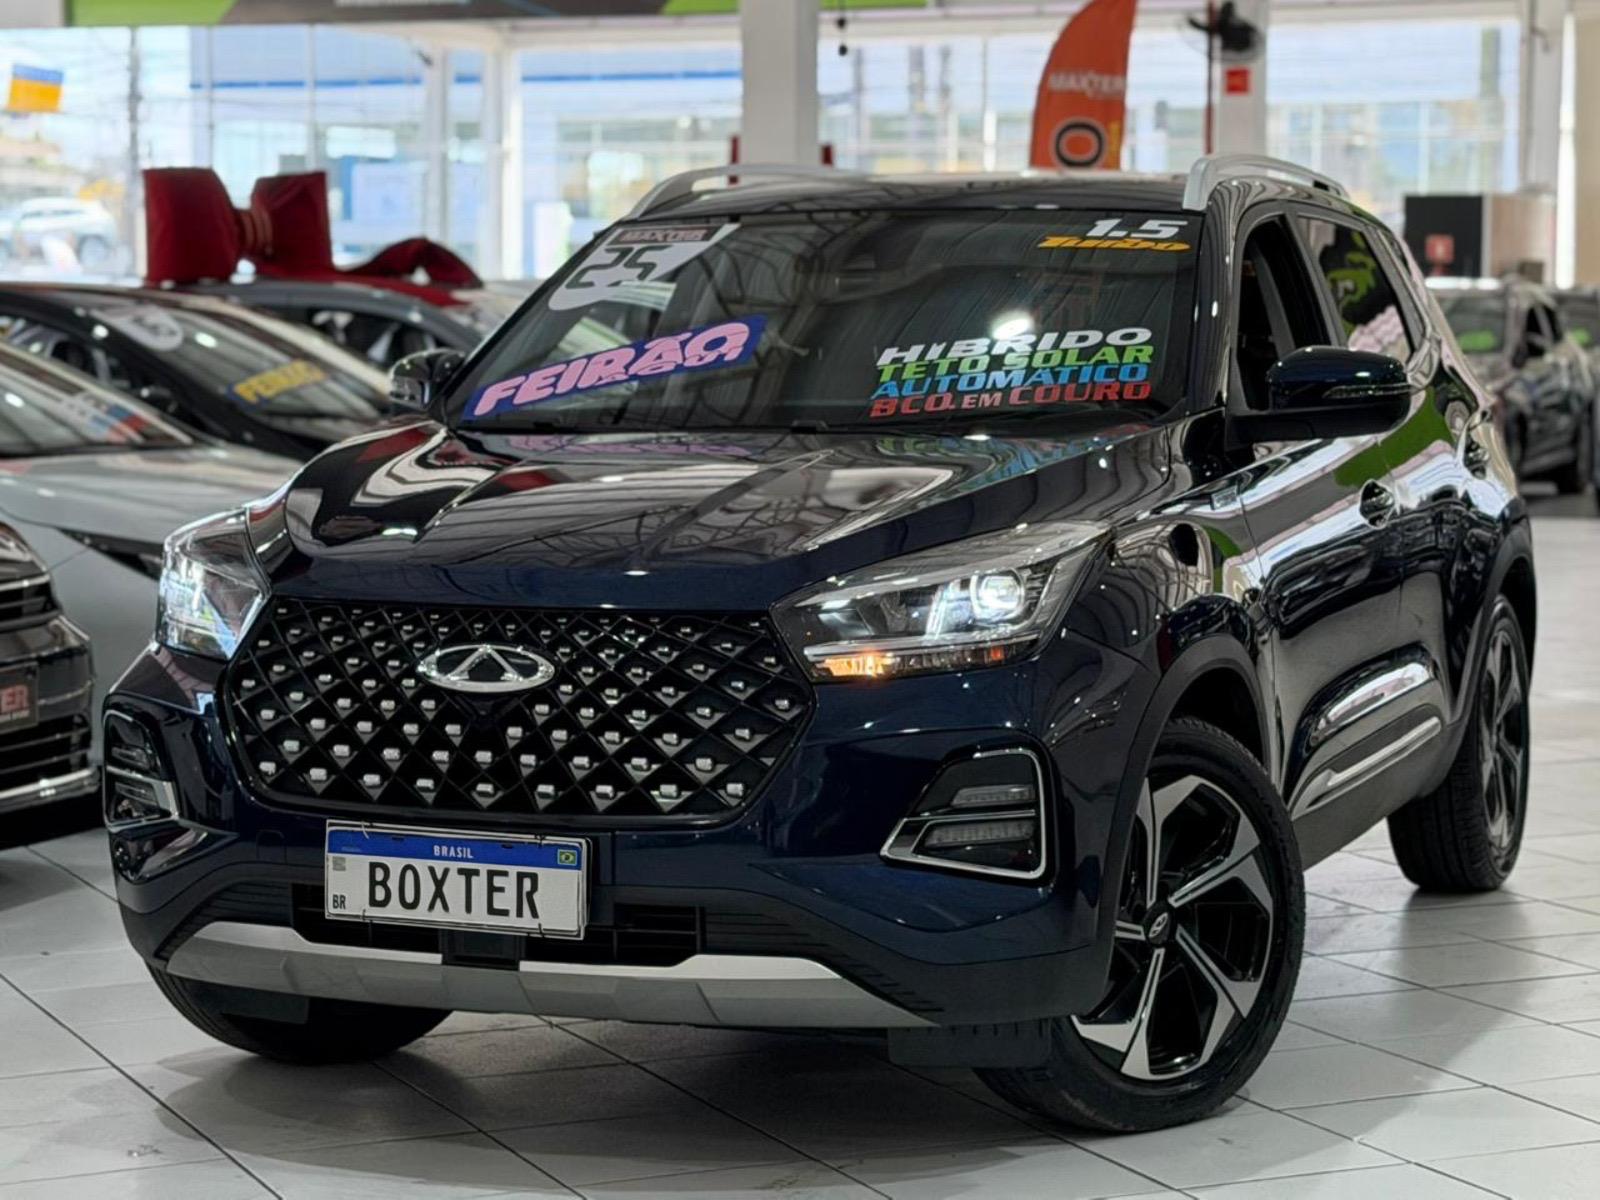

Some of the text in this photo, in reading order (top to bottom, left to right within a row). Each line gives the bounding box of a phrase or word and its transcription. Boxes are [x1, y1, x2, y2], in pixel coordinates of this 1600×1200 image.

[1086, 218, 1189, 239] 1.5
[564, 245, 673, 290] 25
[473, 322, 750, 417] FEIRÃO
[877, 345, 1154, 382] TETO SOLAR
[961, 391, 1003, 409] EM
[1009, 382, 1151, 405] COURO
[433, 844, 474, 859] BRASIL
[332, 893, 347, 910] BR
[368, 861, 540, 919] BOXTER
